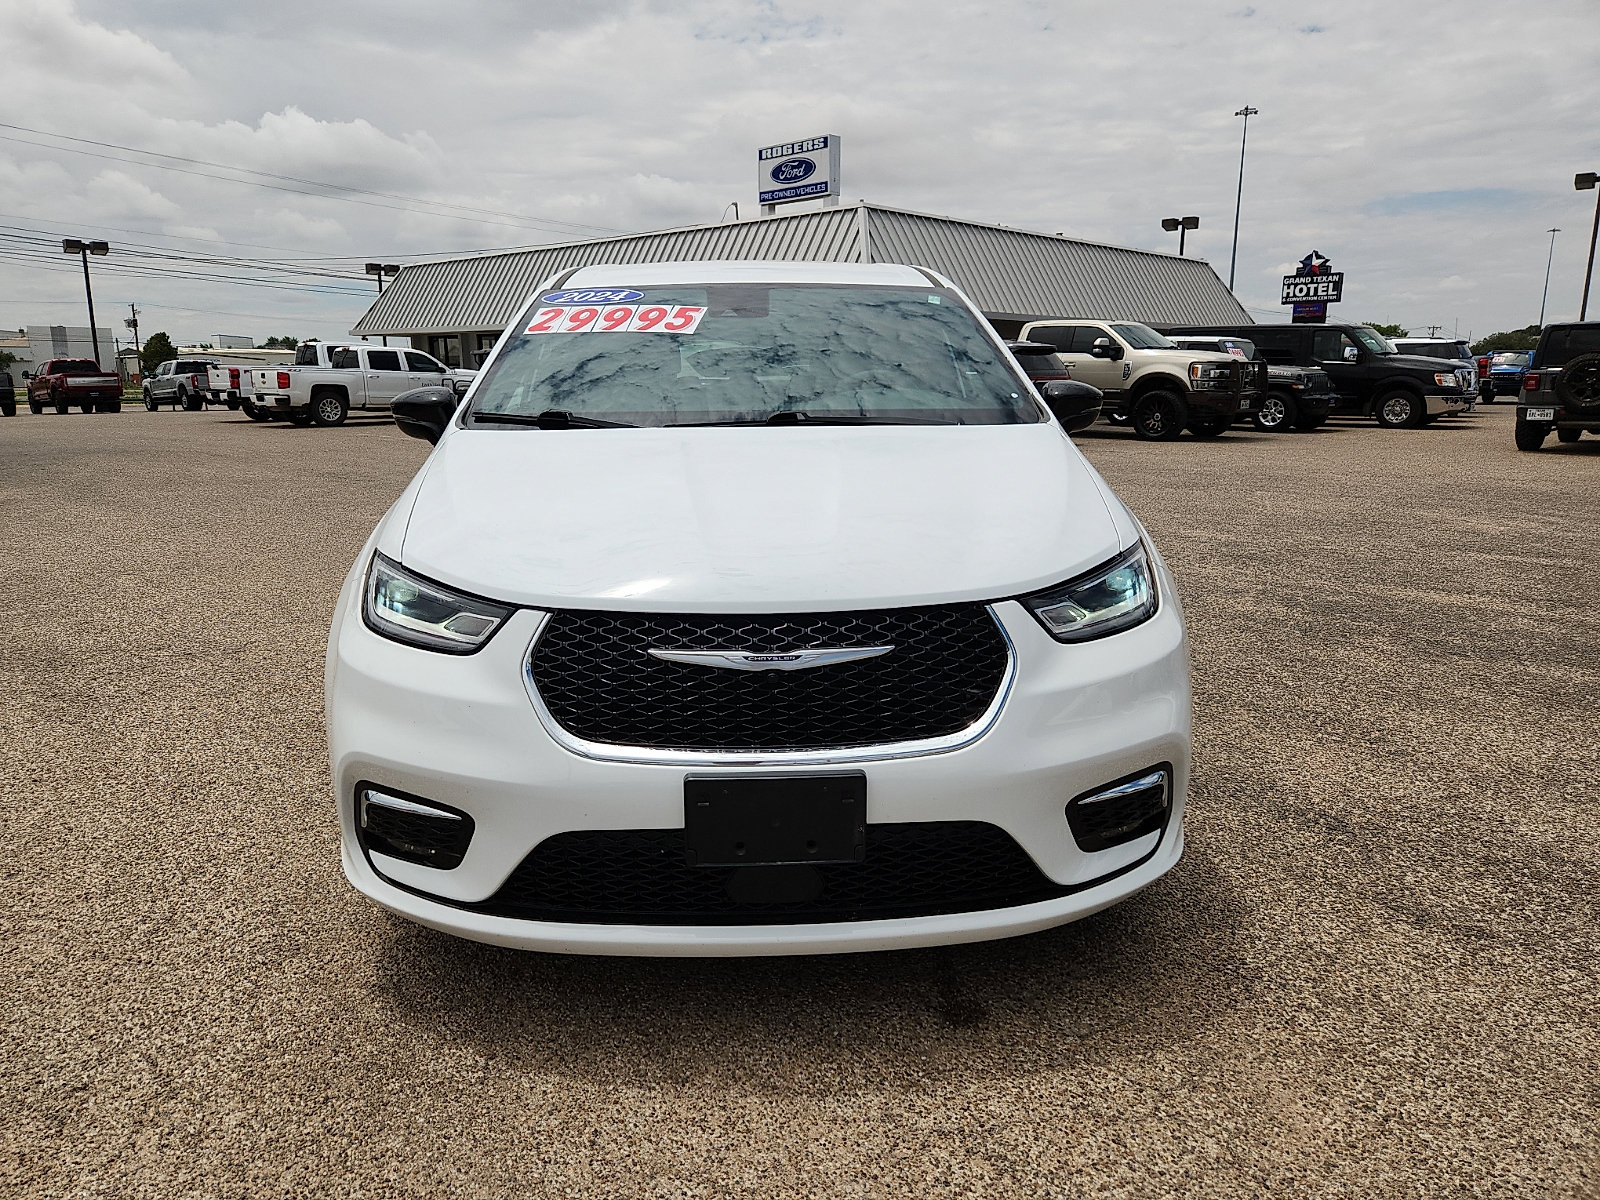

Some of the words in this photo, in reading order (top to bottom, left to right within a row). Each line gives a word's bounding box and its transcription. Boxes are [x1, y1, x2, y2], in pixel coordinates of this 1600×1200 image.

[762, 138, 824, 159] ROGERS
[779, 161, 806, 179] Ford
[761, 190, 796, 201] PRE-OWNED
[796, 183, 826, 195] VEHICLES
[556, 290, 627, 302] 2024
[1283, 283, 1337, 297] HOTEL
[527, 307, 704, 332] 29995
